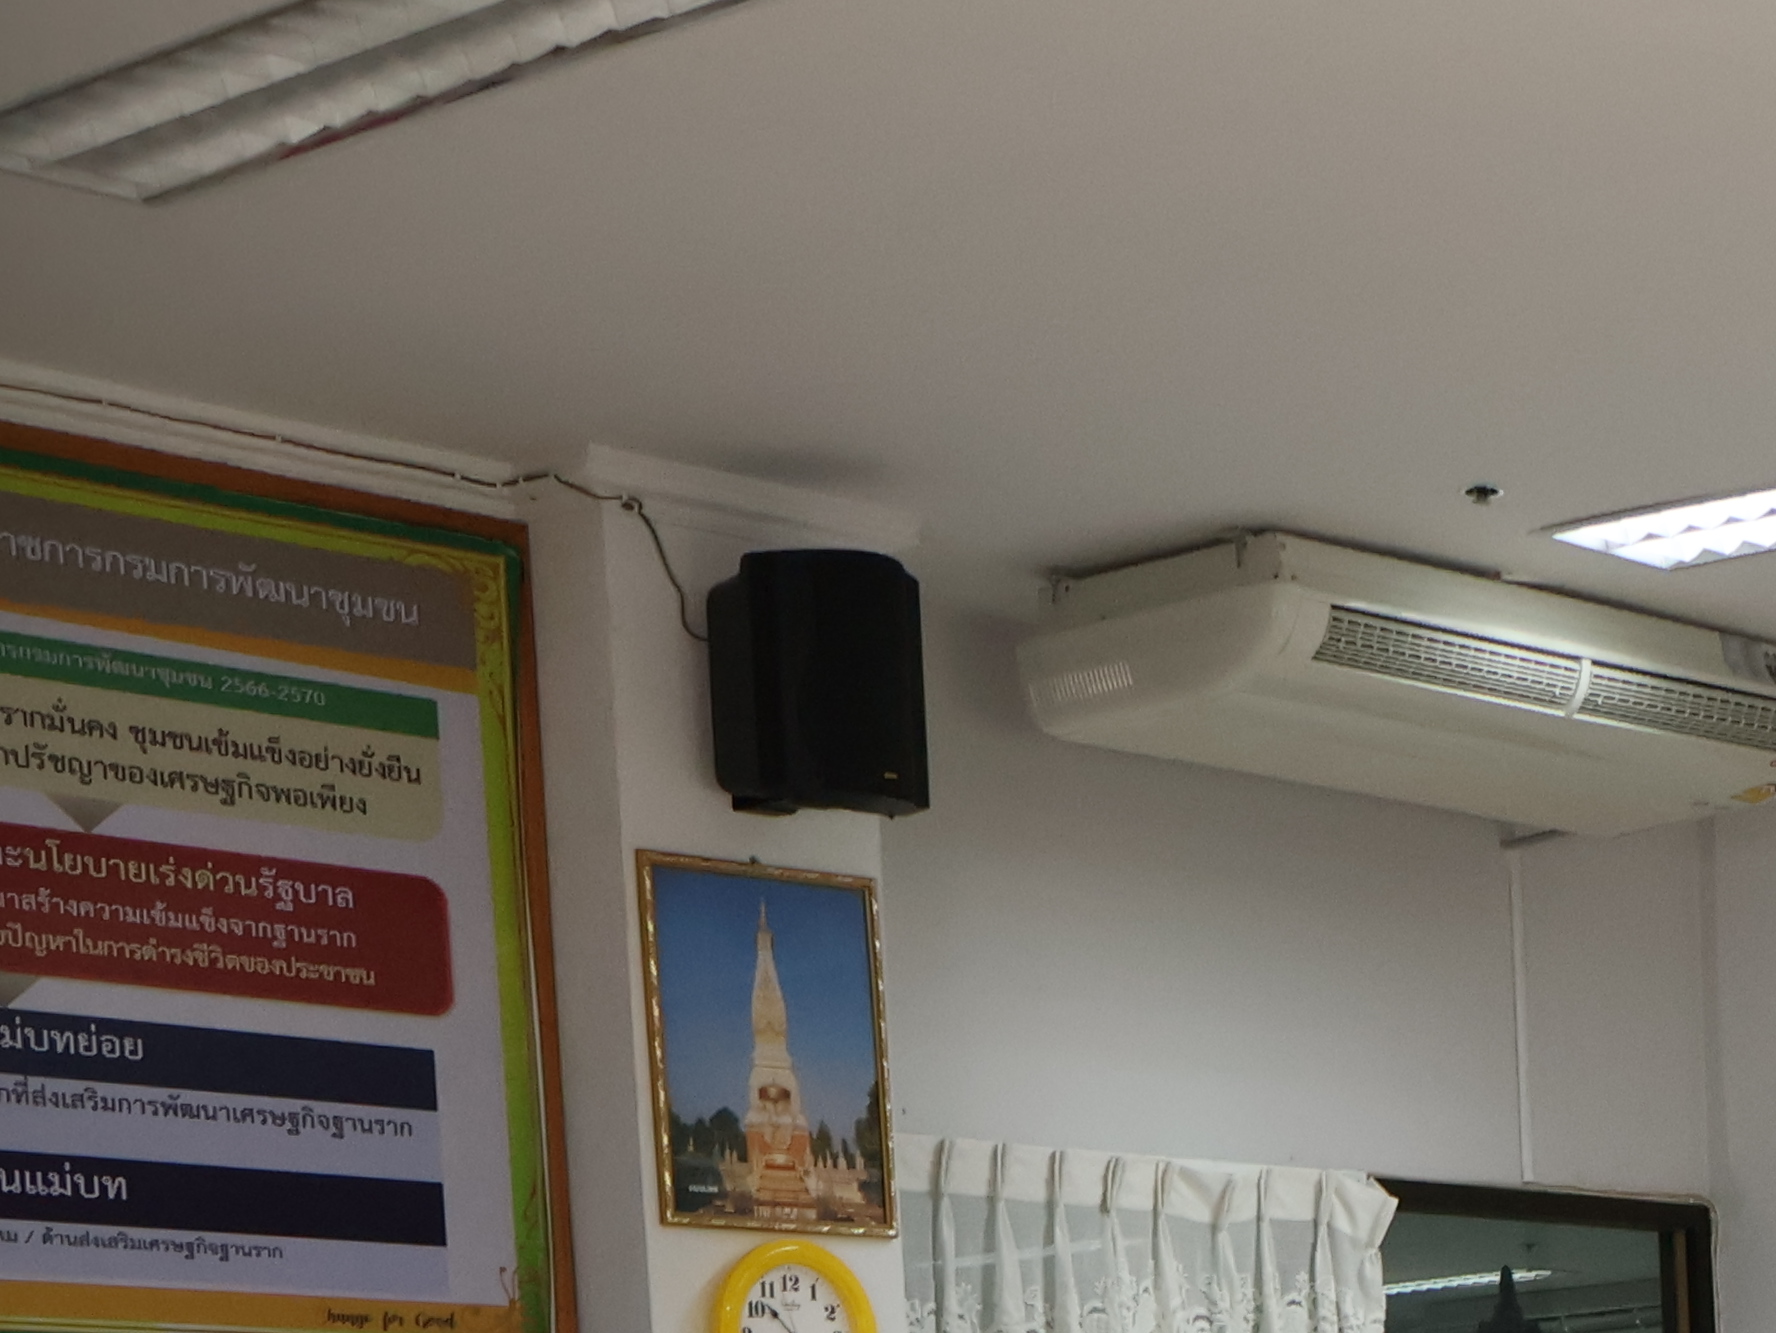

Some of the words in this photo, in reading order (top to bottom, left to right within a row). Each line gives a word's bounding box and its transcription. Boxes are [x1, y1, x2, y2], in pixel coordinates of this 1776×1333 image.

[221, 675, 326, 707] 2566-2570
[129, 728, 421, 785] ชุมชนเข้มแข็งอย่างยั่งยืน
[0, 839, 354, 911] ะนโยบายเร่งด่วนรัฐบาล
[761, 1280, 775, 1299] 11
[781, 1274, 800, 1292] 12
[810, 1283, 817, 1301] 1
[748, 1300, 766, 1318] 10
[824, 1304, 837, 1322] 2
